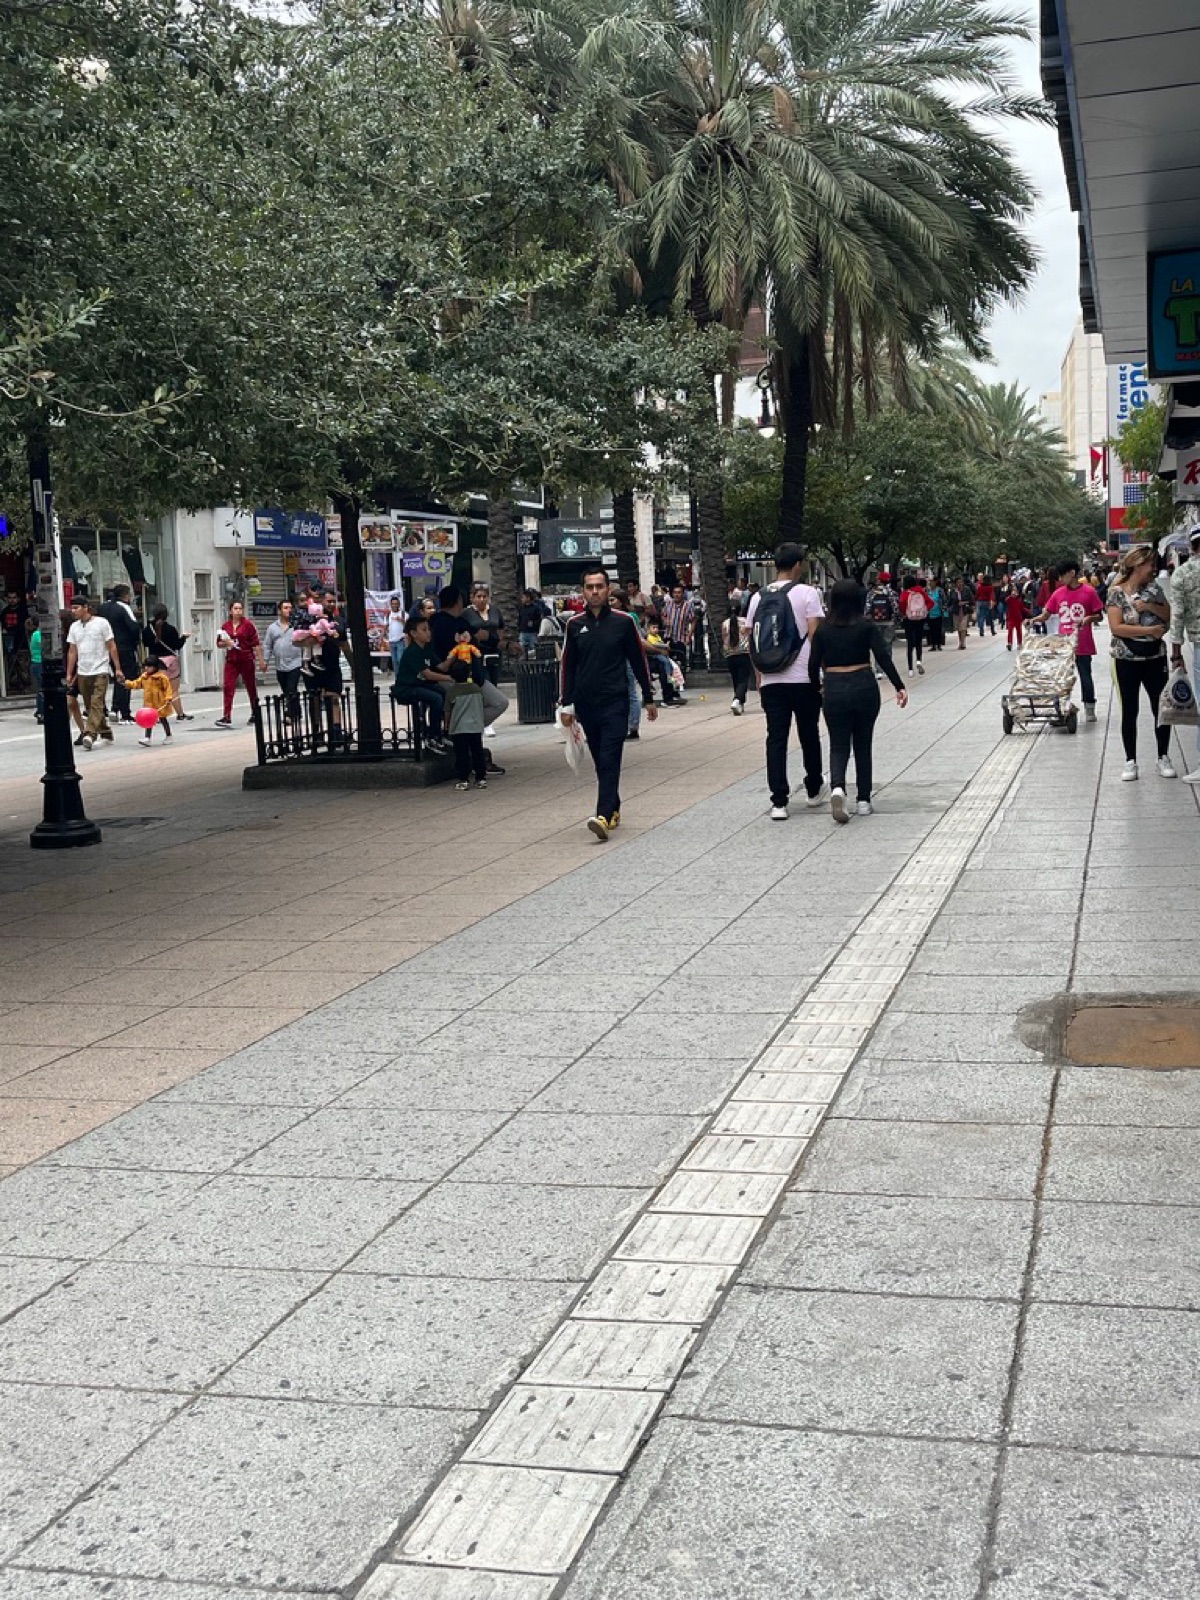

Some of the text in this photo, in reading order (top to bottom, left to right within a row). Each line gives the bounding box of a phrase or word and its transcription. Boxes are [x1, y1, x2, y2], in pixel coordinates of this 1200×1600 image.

[1171, 278, 1193, 293] LA
[1167, 298, 1200, 346] T
[1176, 350, 1200, 361] MAS
[1129, 361, 1149, 411] en
[1183, 458, 1200, 484] R
[300, 519, 323, 537] telcel
